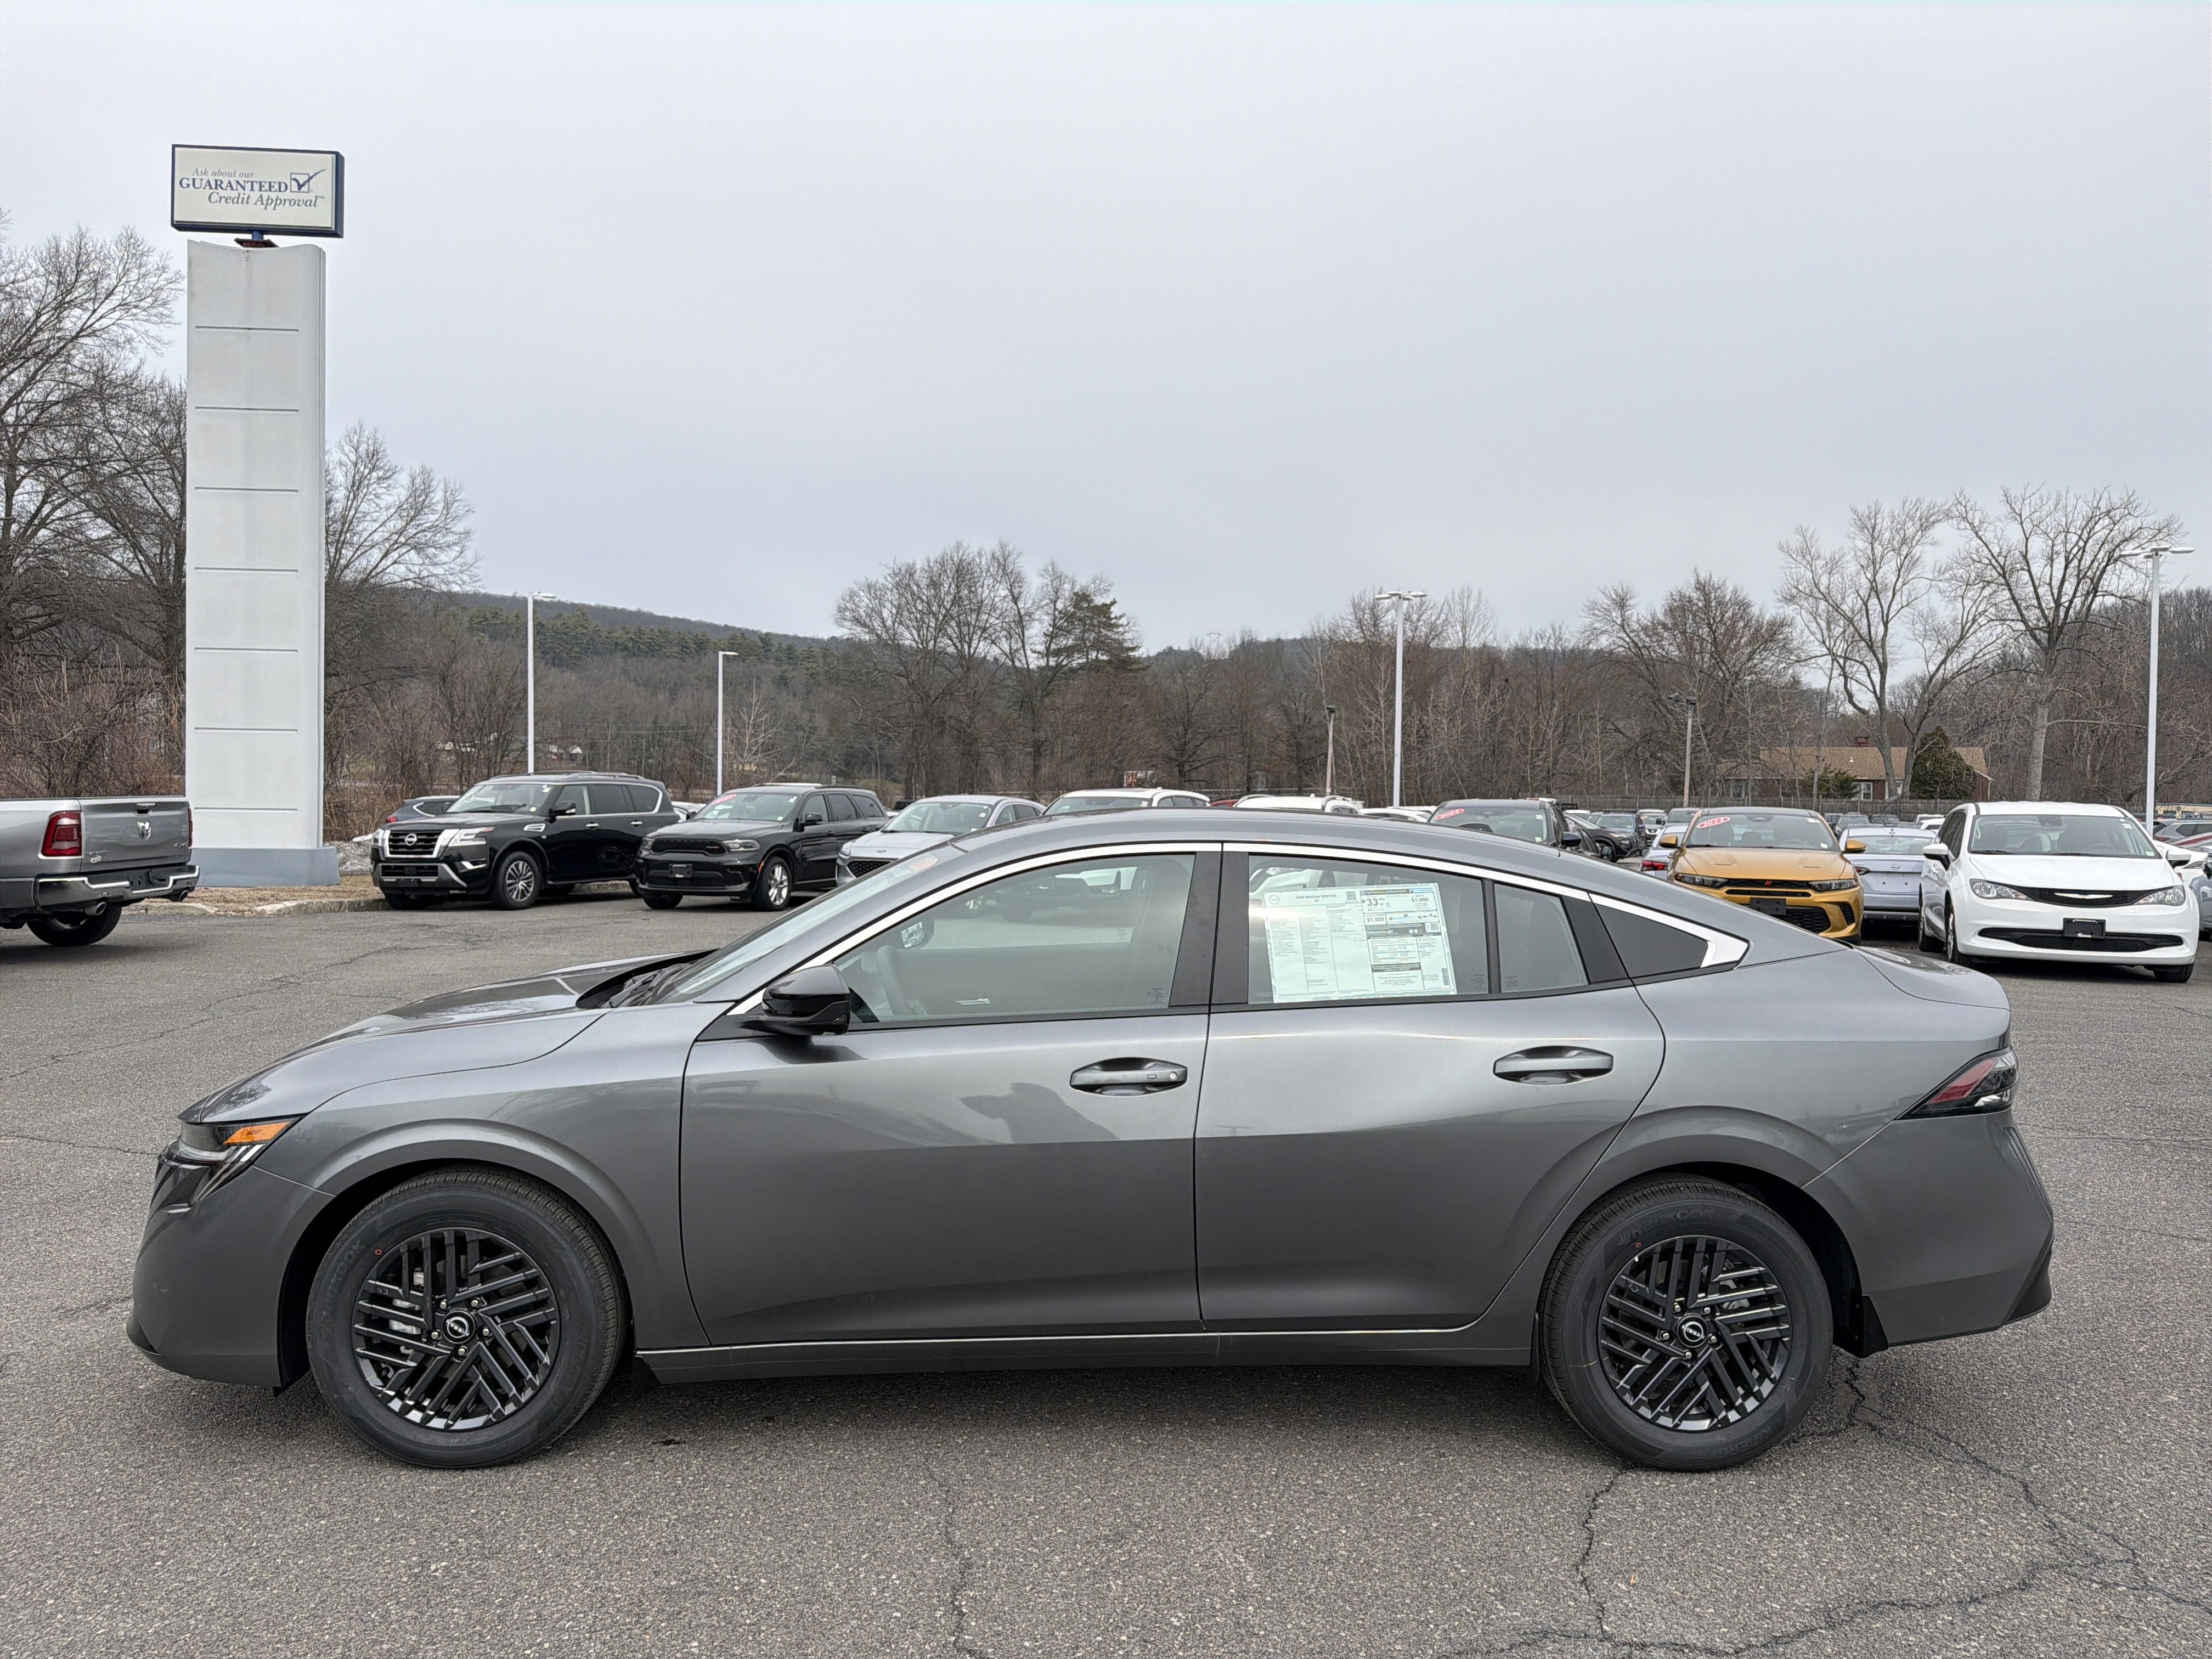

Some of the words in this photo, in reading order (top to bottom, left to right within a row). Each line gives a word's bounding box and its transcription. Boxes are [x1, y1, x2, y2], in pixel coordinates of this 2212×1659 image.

[192, 168, 208, 176] Ask
[211, 168, 236, 178] about
[179, 177, 288, 193] GUARANTEED
[208, 191, 250, 205] Credit
[253, 194, 319, 210] Approval
[1367, 898, 1379, 906] 33
[446, 1319, 470, 1336] NISSAN
[1681, 1325, 1705, 1339] NISSAN
